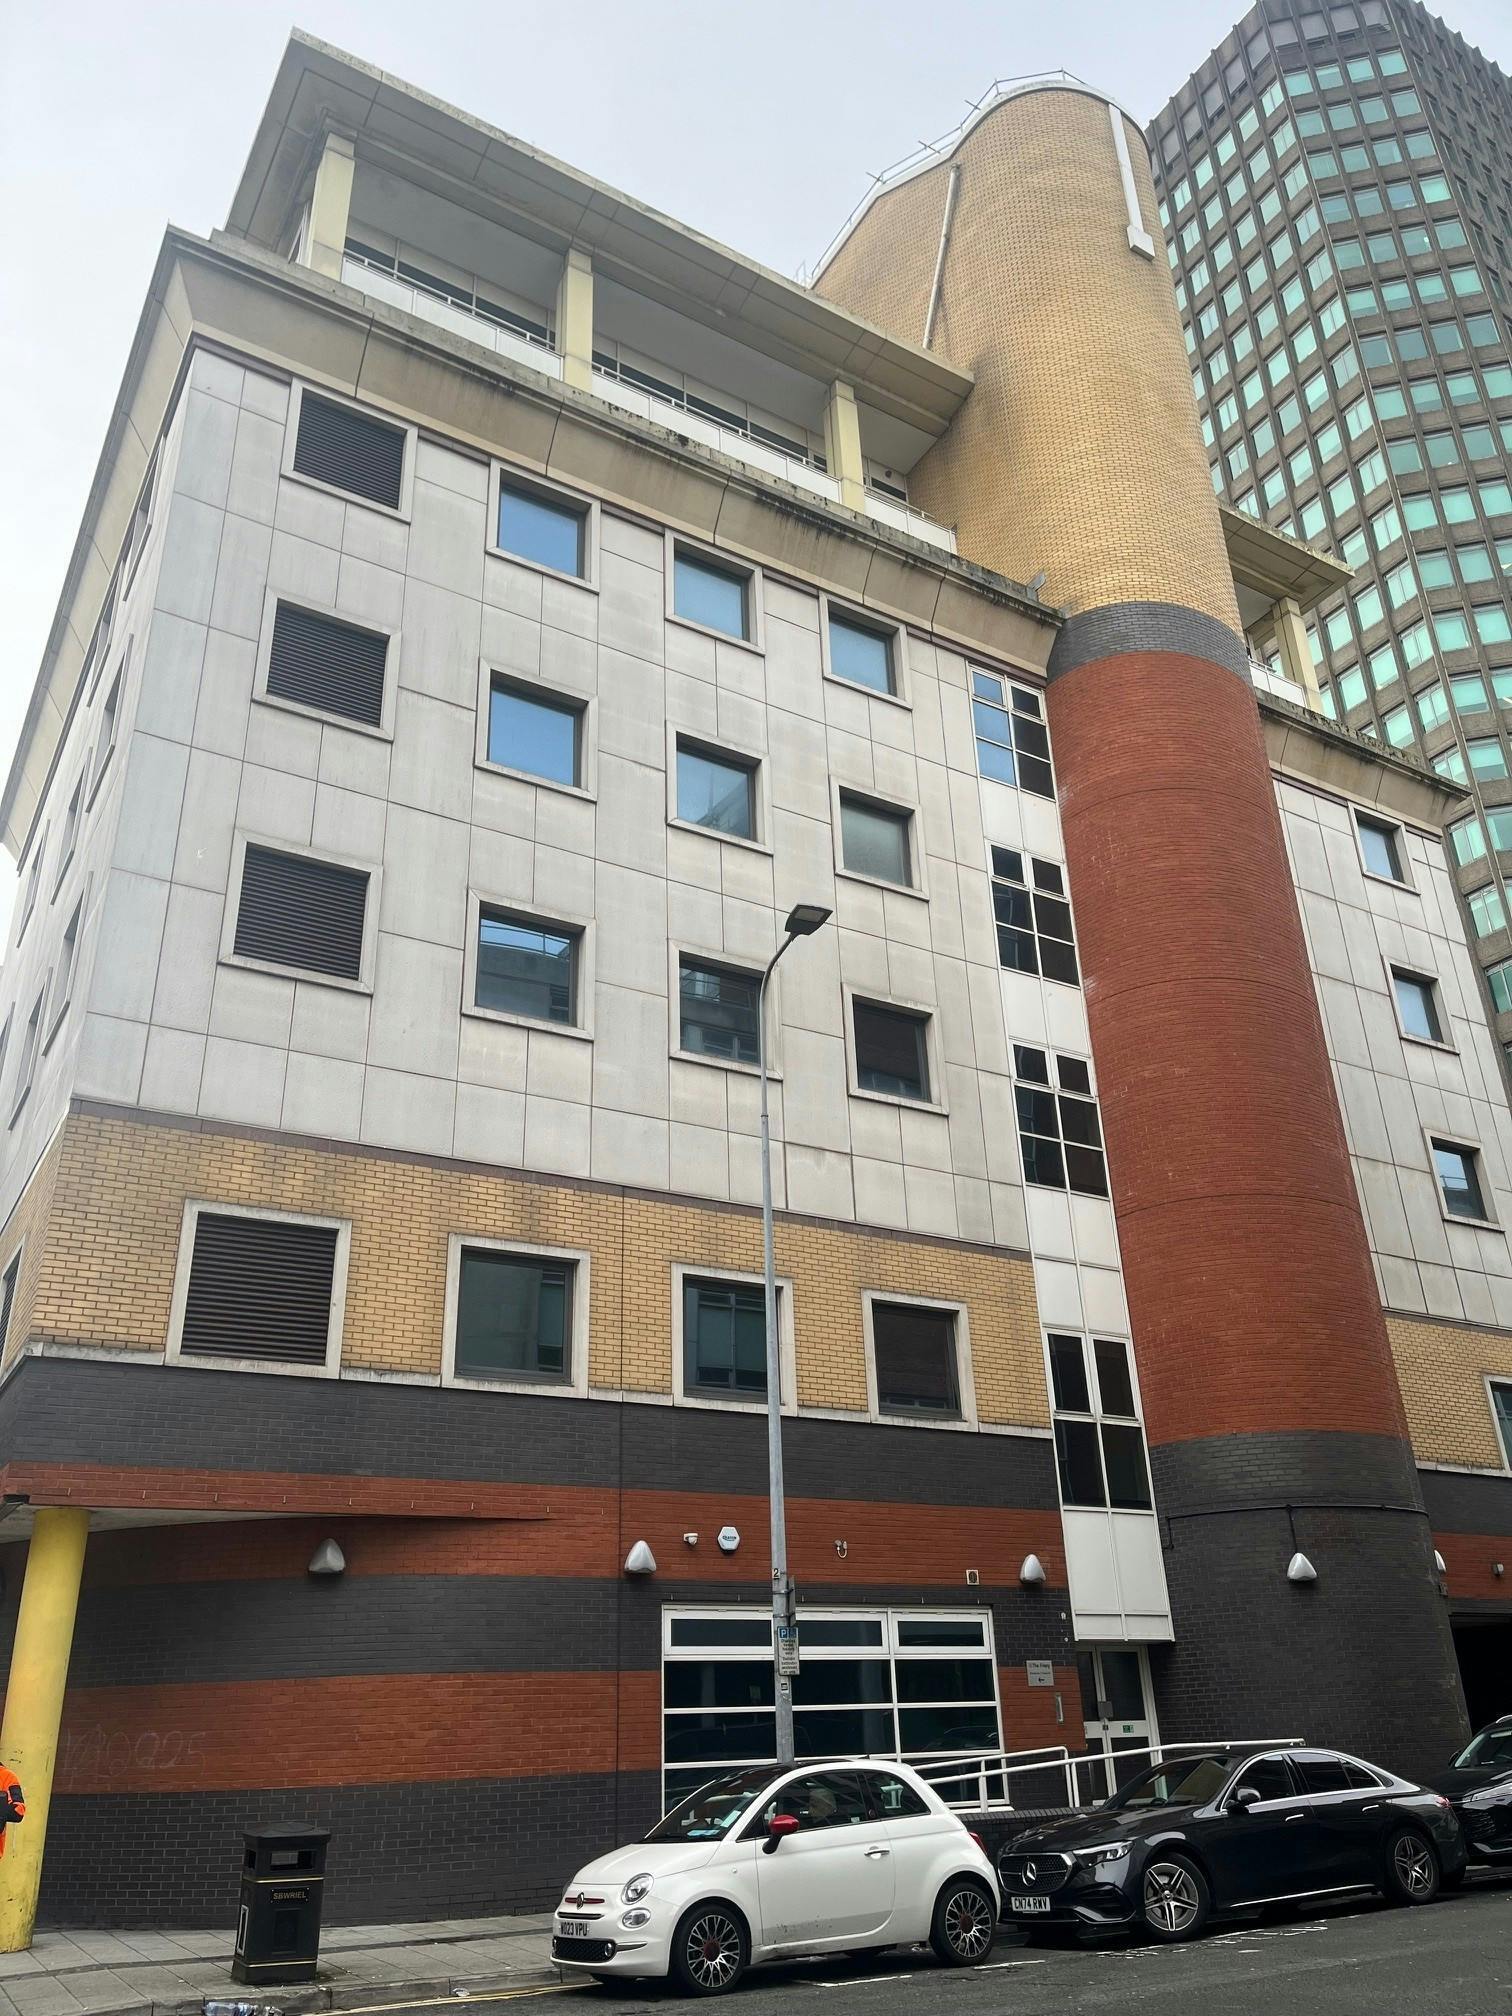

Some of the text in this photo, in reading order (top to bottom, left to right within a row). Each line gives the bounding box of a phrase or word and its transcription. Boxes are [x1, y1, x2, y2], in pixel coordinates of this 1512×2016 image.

[773, 1568, 779, 1578] 2
[781, 1629, 787, 1638] P
[273, 1892, 306, 1900] SBWRIEL
